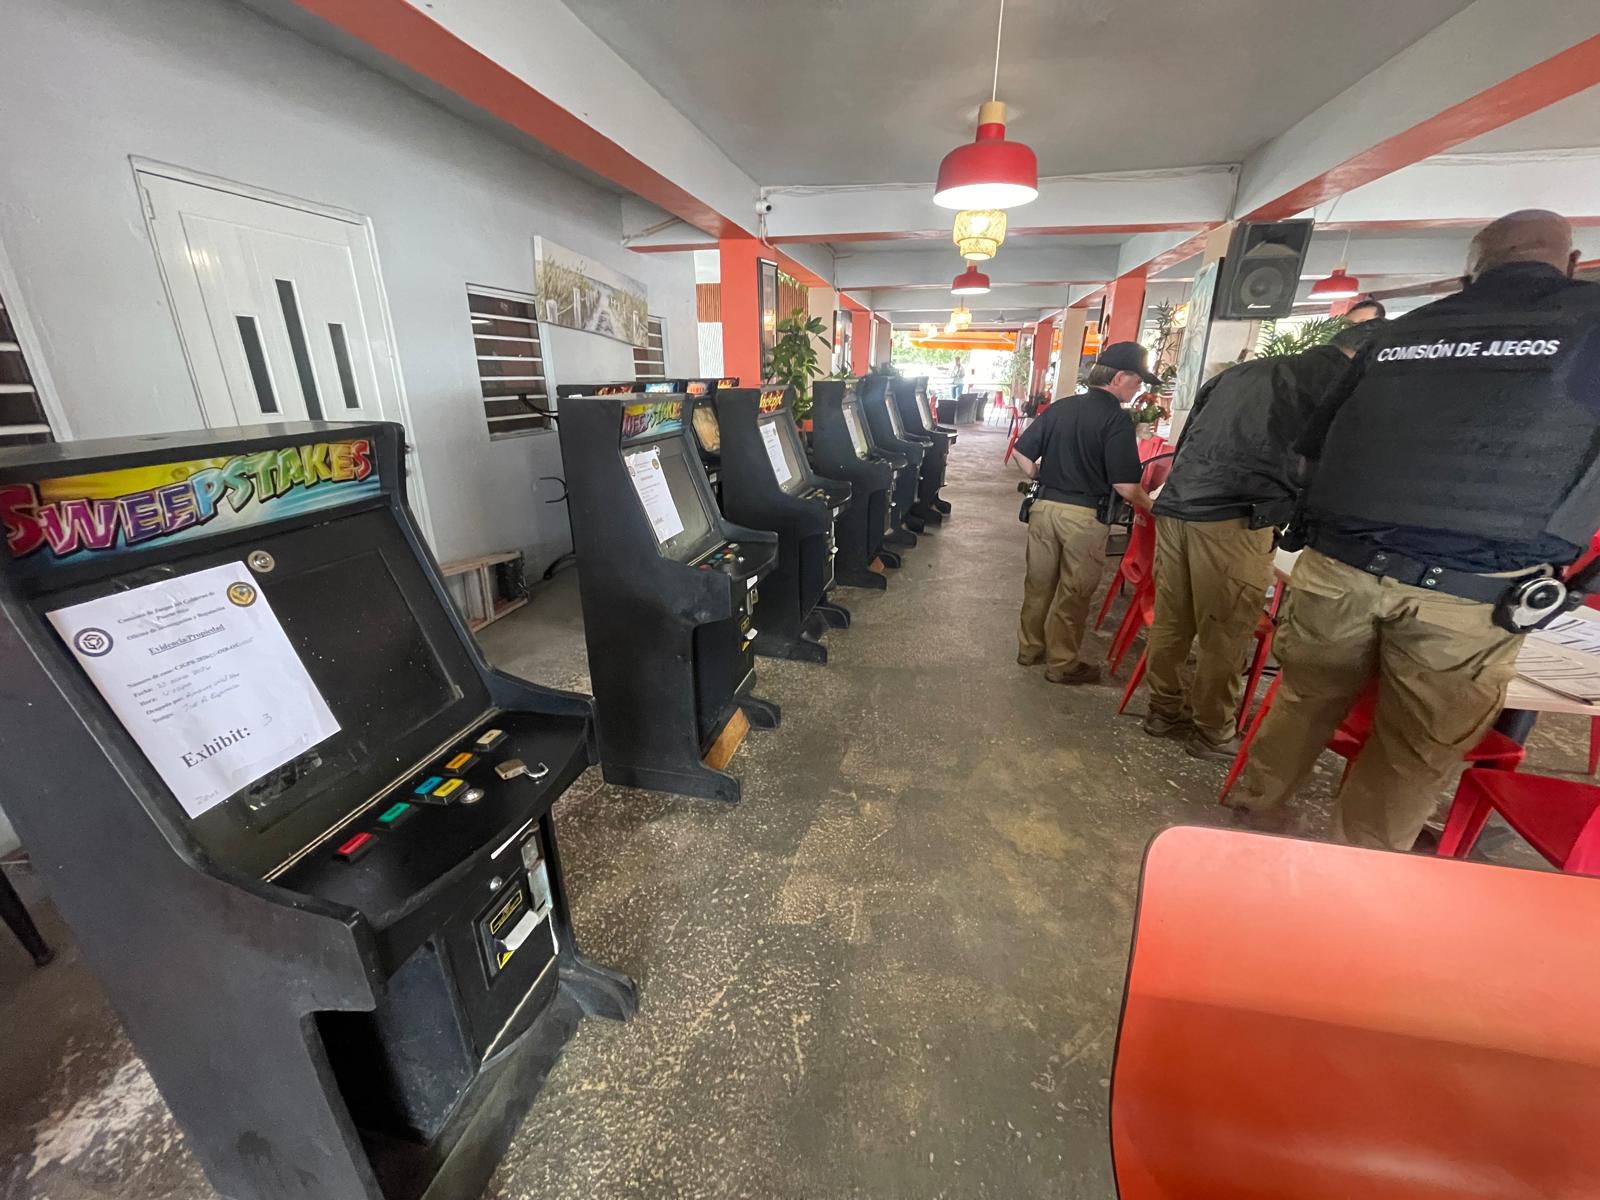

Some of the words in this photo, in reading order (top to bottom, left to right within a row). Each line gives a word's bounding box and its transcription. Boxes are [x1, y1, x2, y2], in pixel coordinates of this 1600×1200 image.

[1377, 339, 1452, 362] COMISIÓN
[1455, 341, 1482, 357] DE
[1482, 339, 1561, 357] JUEGOS
[0, 438, 371, 559] SWEEPSTAKES
[181, 726, 251, 768] Exhibit:
